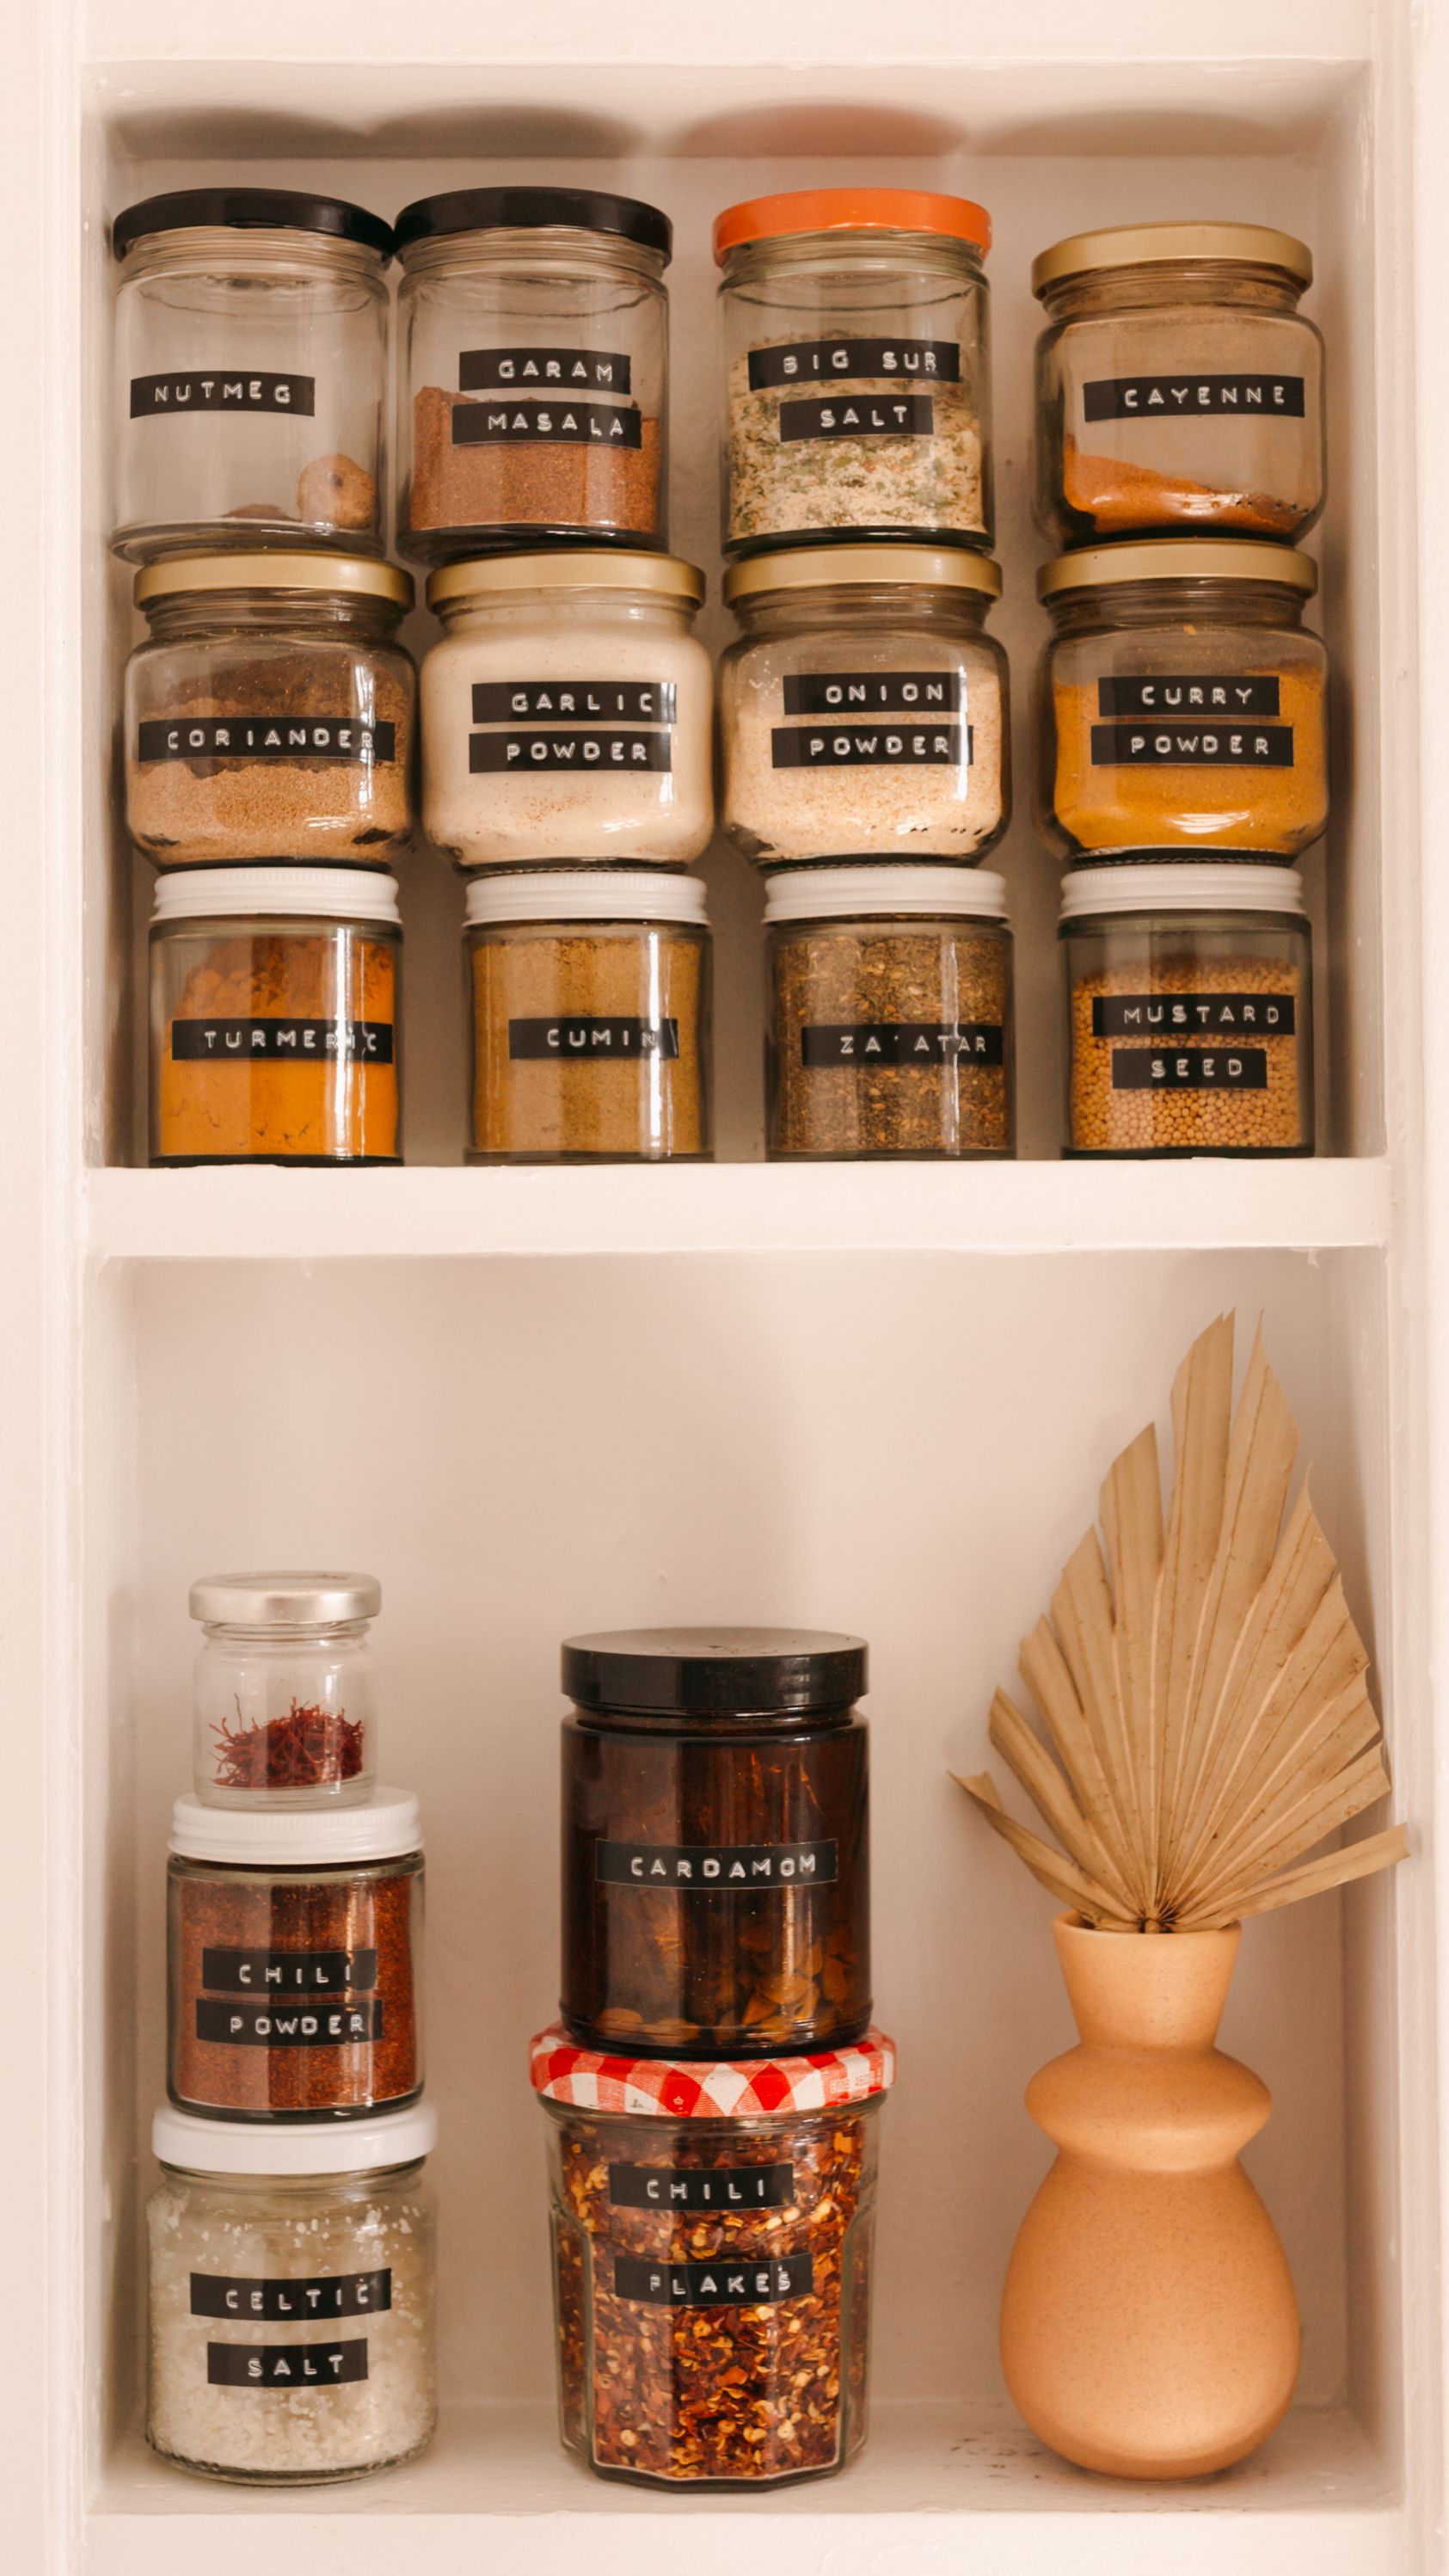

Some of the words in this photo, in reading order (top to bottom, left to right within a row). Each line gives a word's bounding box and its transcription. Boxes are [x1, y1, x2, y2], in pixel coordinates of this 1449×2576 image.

[499, 360, 612, 381] GARAM
[783, 351, 849, 372] BIG
[882, 351, 937, 372] SUR
[155, 381, 291, 403] NUTMEG
[1124, 384, 1285, 408] CAYENNE
[488, 413, 623, 437] MASALA
[820, 405, 908, 427] SALT
[512, 692, 653, 712] GARLIC
[826, 683, 942, 704] ONION
[1141, 685, 1252, 705] CURRY
[168, 728, 373, 750] CORIANDER
[809, 736, 949, 756] POWDER
[1131, 735, 1268, 755] POWDER
[507, 741, 647, 761] POWDER
[1124, 1005, 1279, 1024] MUSTARD
[205, 1030, 376, 1051] TURMERIC
[547, 1028, 657, 1048] CUMIN
[1151, 1059, 1243, 1078] SEED
[631, 1854, 816, 1878] CARDAMOM
[239, 1964, 351, 1984] CHILI
[230, 2014, 365, 2035] POWDER
[647, 2179, 764, 2200] CHILI
[650, 2272, 790, 2296] FLAKES
[226, 2284, 368, 2310] CELTIC
[248, 2354, 343, 2376] SALT
